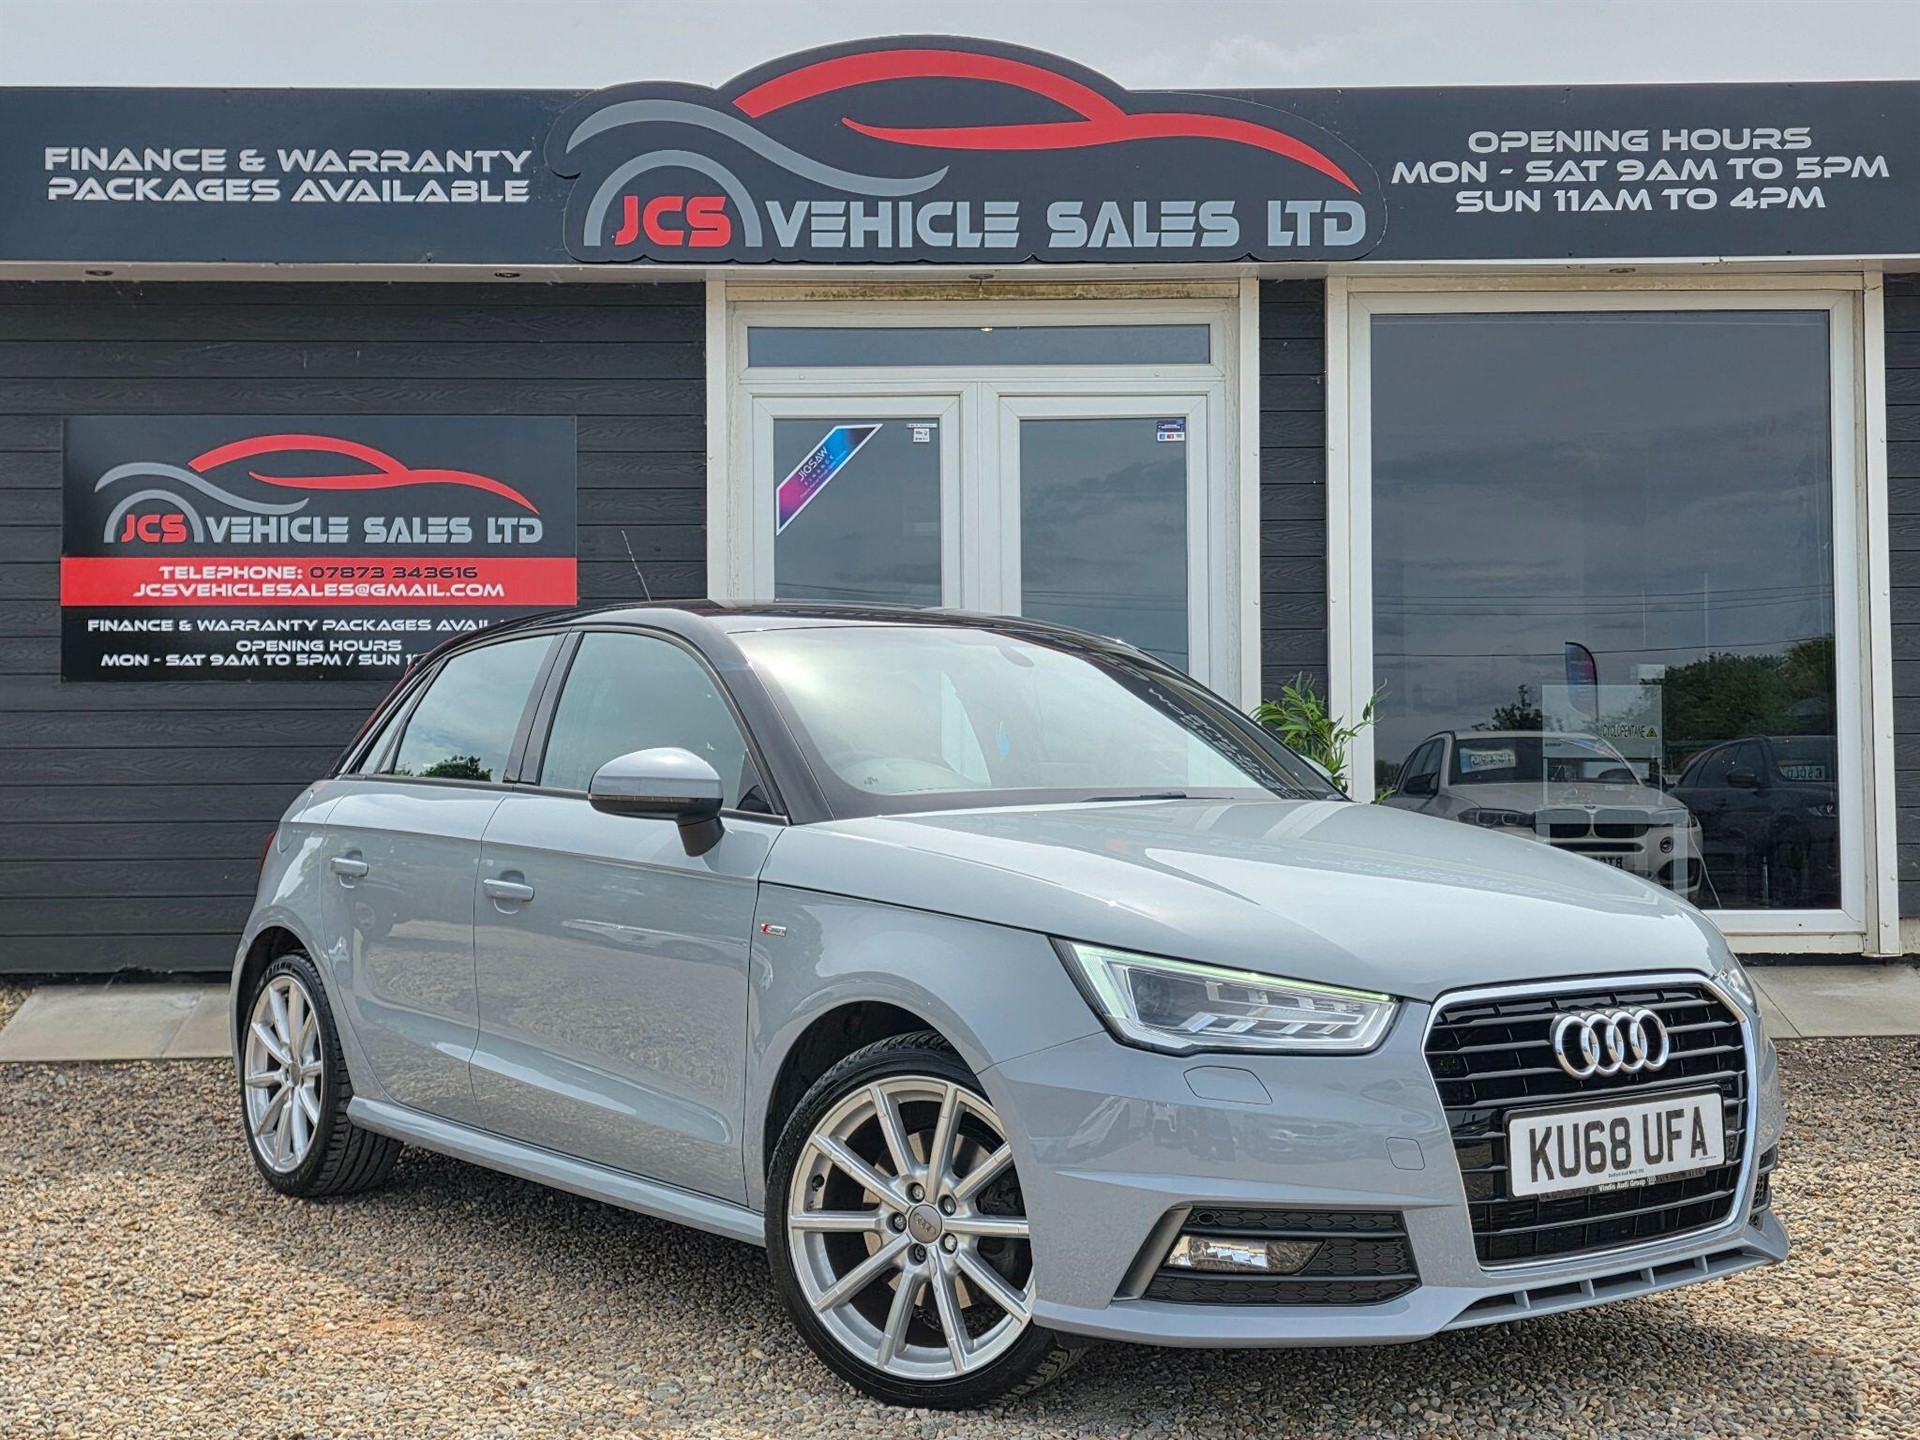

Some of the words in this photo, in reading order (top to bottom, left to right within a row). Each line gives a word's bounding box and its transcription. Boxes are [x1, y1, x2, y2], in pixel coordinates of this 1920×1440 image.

[1469, 130, 1648, 153] OPENING
[1663, 128, 1811, 150] HOURS
[45, 148, 226, 171] FINANCE
[239, 150, 265, 171] &
[277, 149, 535, 172] WARRANTY
[1392, 161, 1486, 183] MON
[1526, 160, 1607, 182] SAT
[1617, 159, 1718, 181] 9AM
[1727, 158, 1782, 179] TO
[1797, 156, 1889, 178] 5PM
[49, 178, 280, 201] PACKAGES
[291, 180, 529, 202] AVAILABLE
[1456, 190, 1540, 212] SUN
[1553, 189, 1652, 211] 11AM
[1662, 188, 1717, 210] TO
[1730, 187, 1825, 208] 4PM
[616, 196, 731, 246] JCS
[767, 201, 1019, 247] VEHICLE
[1047, 201, 1239, 247] SALES
[1268, 201, 1365, 246] LTD
[799, 446, 828, 482] JIGSAW
[122, 515, 187, 543] JCS
[205, 516, 348, 543] VEHICLE
[364, 517, 472, 543] SALES
[487, 517, 543, 543] LTD
[160, 566, 302, 579] TELEPHONE:
[310, 567, 384, 578] 07873
[393, 567, 477, 578] 343616
[134, 584, 504, 596] JCSVEHICLESALES@GMAIL.COM
[88, 620, 173, 631] FINANCE
[179, 620, 191, 631] &
[197, 620, 317, 631] WARRANTY
[323, 620, 431, 631] PACKAGES
[236, 639, 323, 652] OPENING
[327, 639, 402, 652] HOURS
[101, 655, 148, 666] MON
[166, 655, 206, 665] SAT
[210, 654, 259, 665] 9AM
[263, 654, 290, 665] TO
[297, 654, 341, 665] 5PM
[359, 654, 400, 665] SUN
[1529, 1117, 1632, 1183] KU68
[1642, 1106, 1708, 1165] UFA
